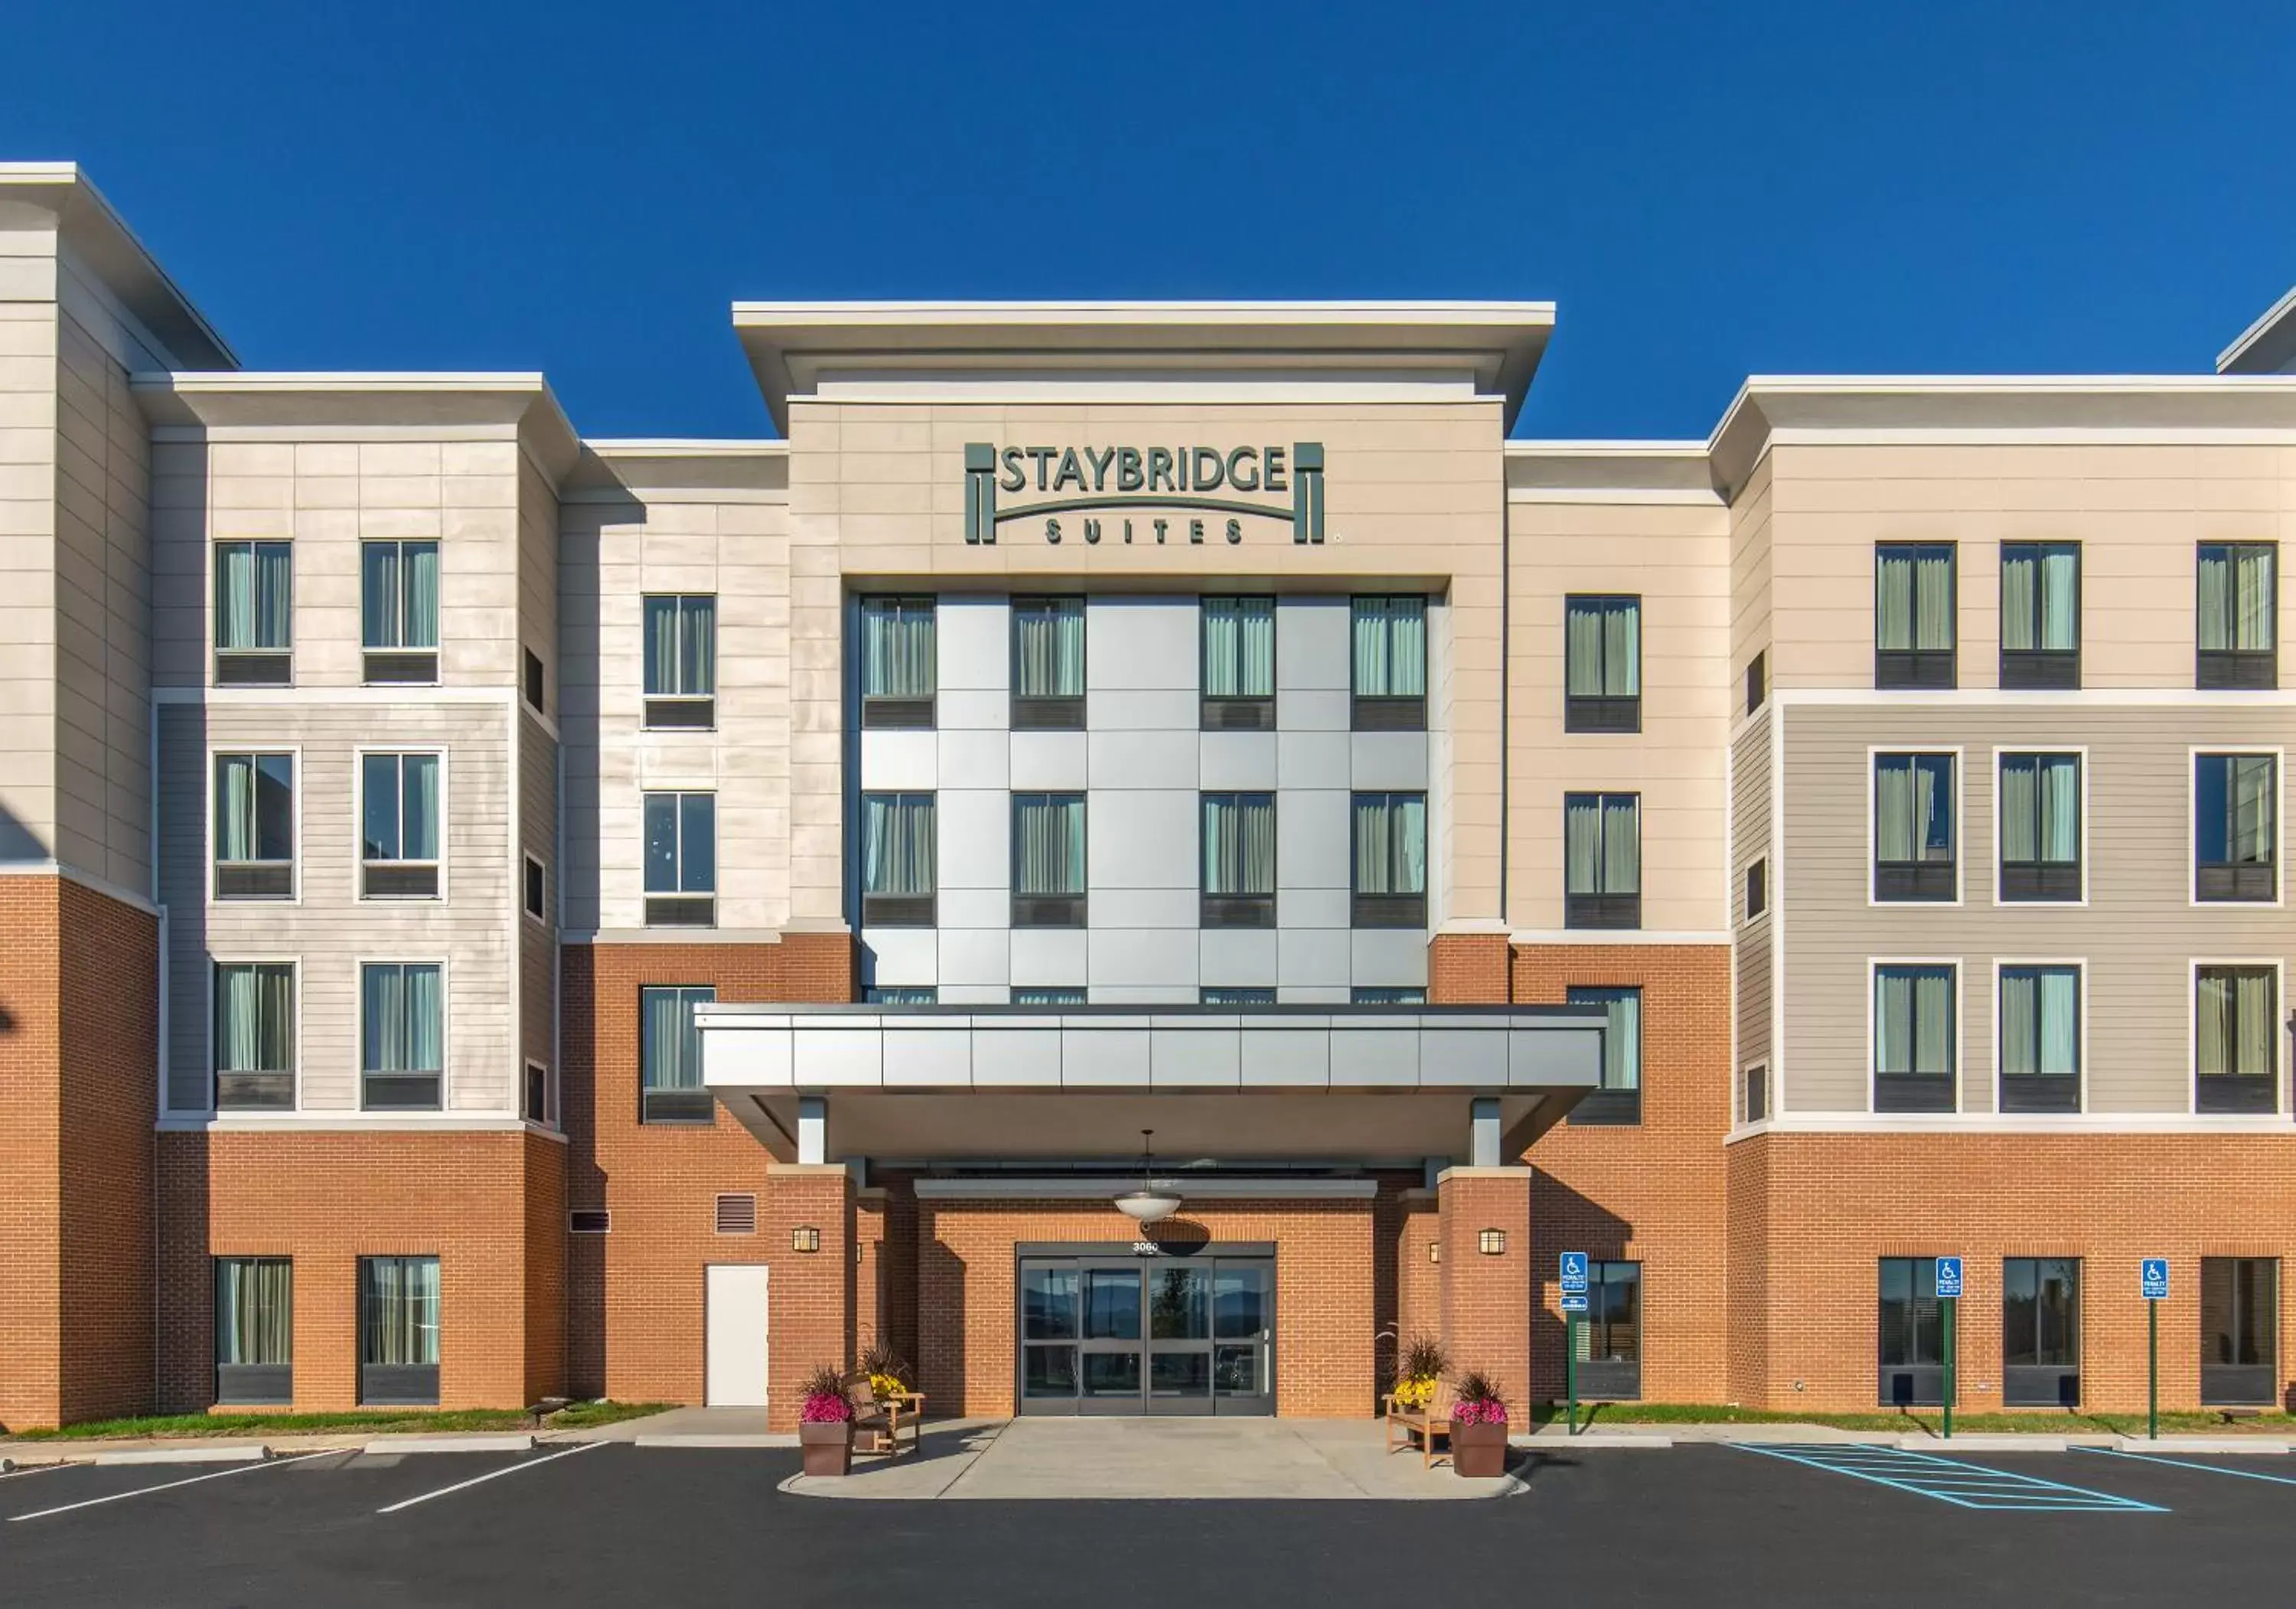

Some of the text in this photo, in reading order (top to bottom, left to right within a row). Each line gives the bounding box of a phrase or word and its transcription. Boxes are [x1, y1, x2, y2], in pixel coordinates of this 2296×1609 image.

[1000, 446, 1288, 492] STAYBRIDGE
[1045, 518, 1243, 544] SUITES
[1133, 1242, 1158, 1252] 3060
